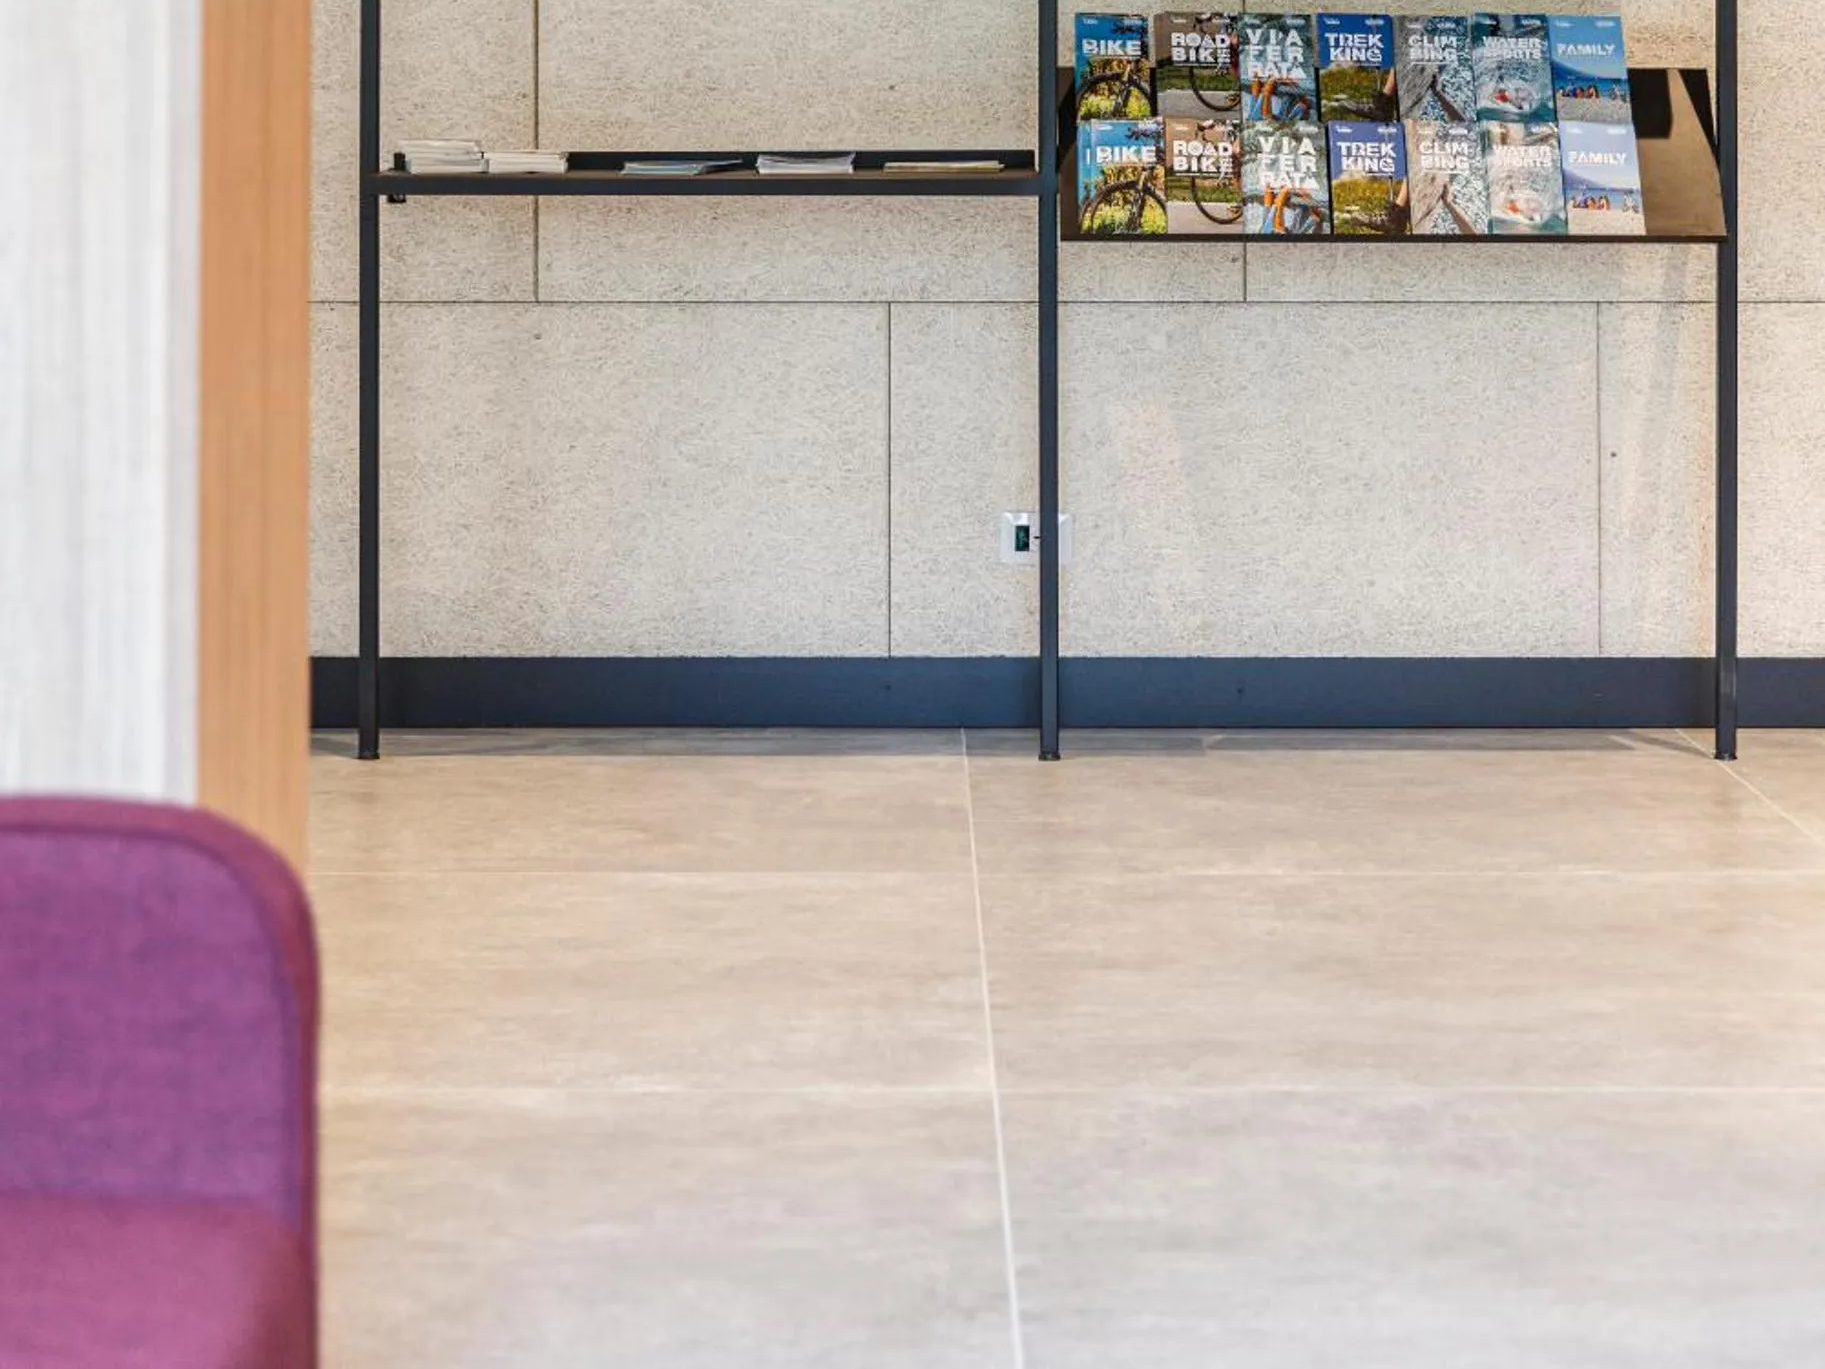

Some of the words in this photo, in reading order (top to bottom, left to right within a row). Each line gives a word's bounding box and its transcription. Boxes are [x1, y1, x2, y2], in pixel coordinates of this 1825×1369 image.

[1171, 32, 1231, 48] ROAD
[1246, 28, 1304, 47] VIA
[1324, 32, 1385, 48] TREK
[1483, 37, 1542, 49] WATER
[1082, 38, 1141, 56] BIKE
[1171, 47, 1231, 63] BIKE
[1246, 45, 1304, 62] FER
[1330, 47, 1383, 62] KING
[1410, 48, 1459, 61] BING
[1483, 49, 1542, 60] SPORTS
[1556, 43, 1616, 56] FAMILY
[1247, 62, 1307, 80] RATA
[1173, 140, 1233, 157] ROAD
[1258, 136, 1317, 155] VIA
[1337, 142, 1397, 158] TREK
[1493, 145, 1551, 156] WATER
[1096, 145, 1156, 164] BIKE
[1257, 153, 1317, 172] FER
[1420, 155, 1470, 170] BING
[1493, 156, 1551, 168] SPORTS
[1568, 151, 1627, 164] FAMILY
[1173, 156, 1233, 173] BIKE
[1342, 156, 1395, 172] KING
[1259, 171, 1319, 189] RATA
